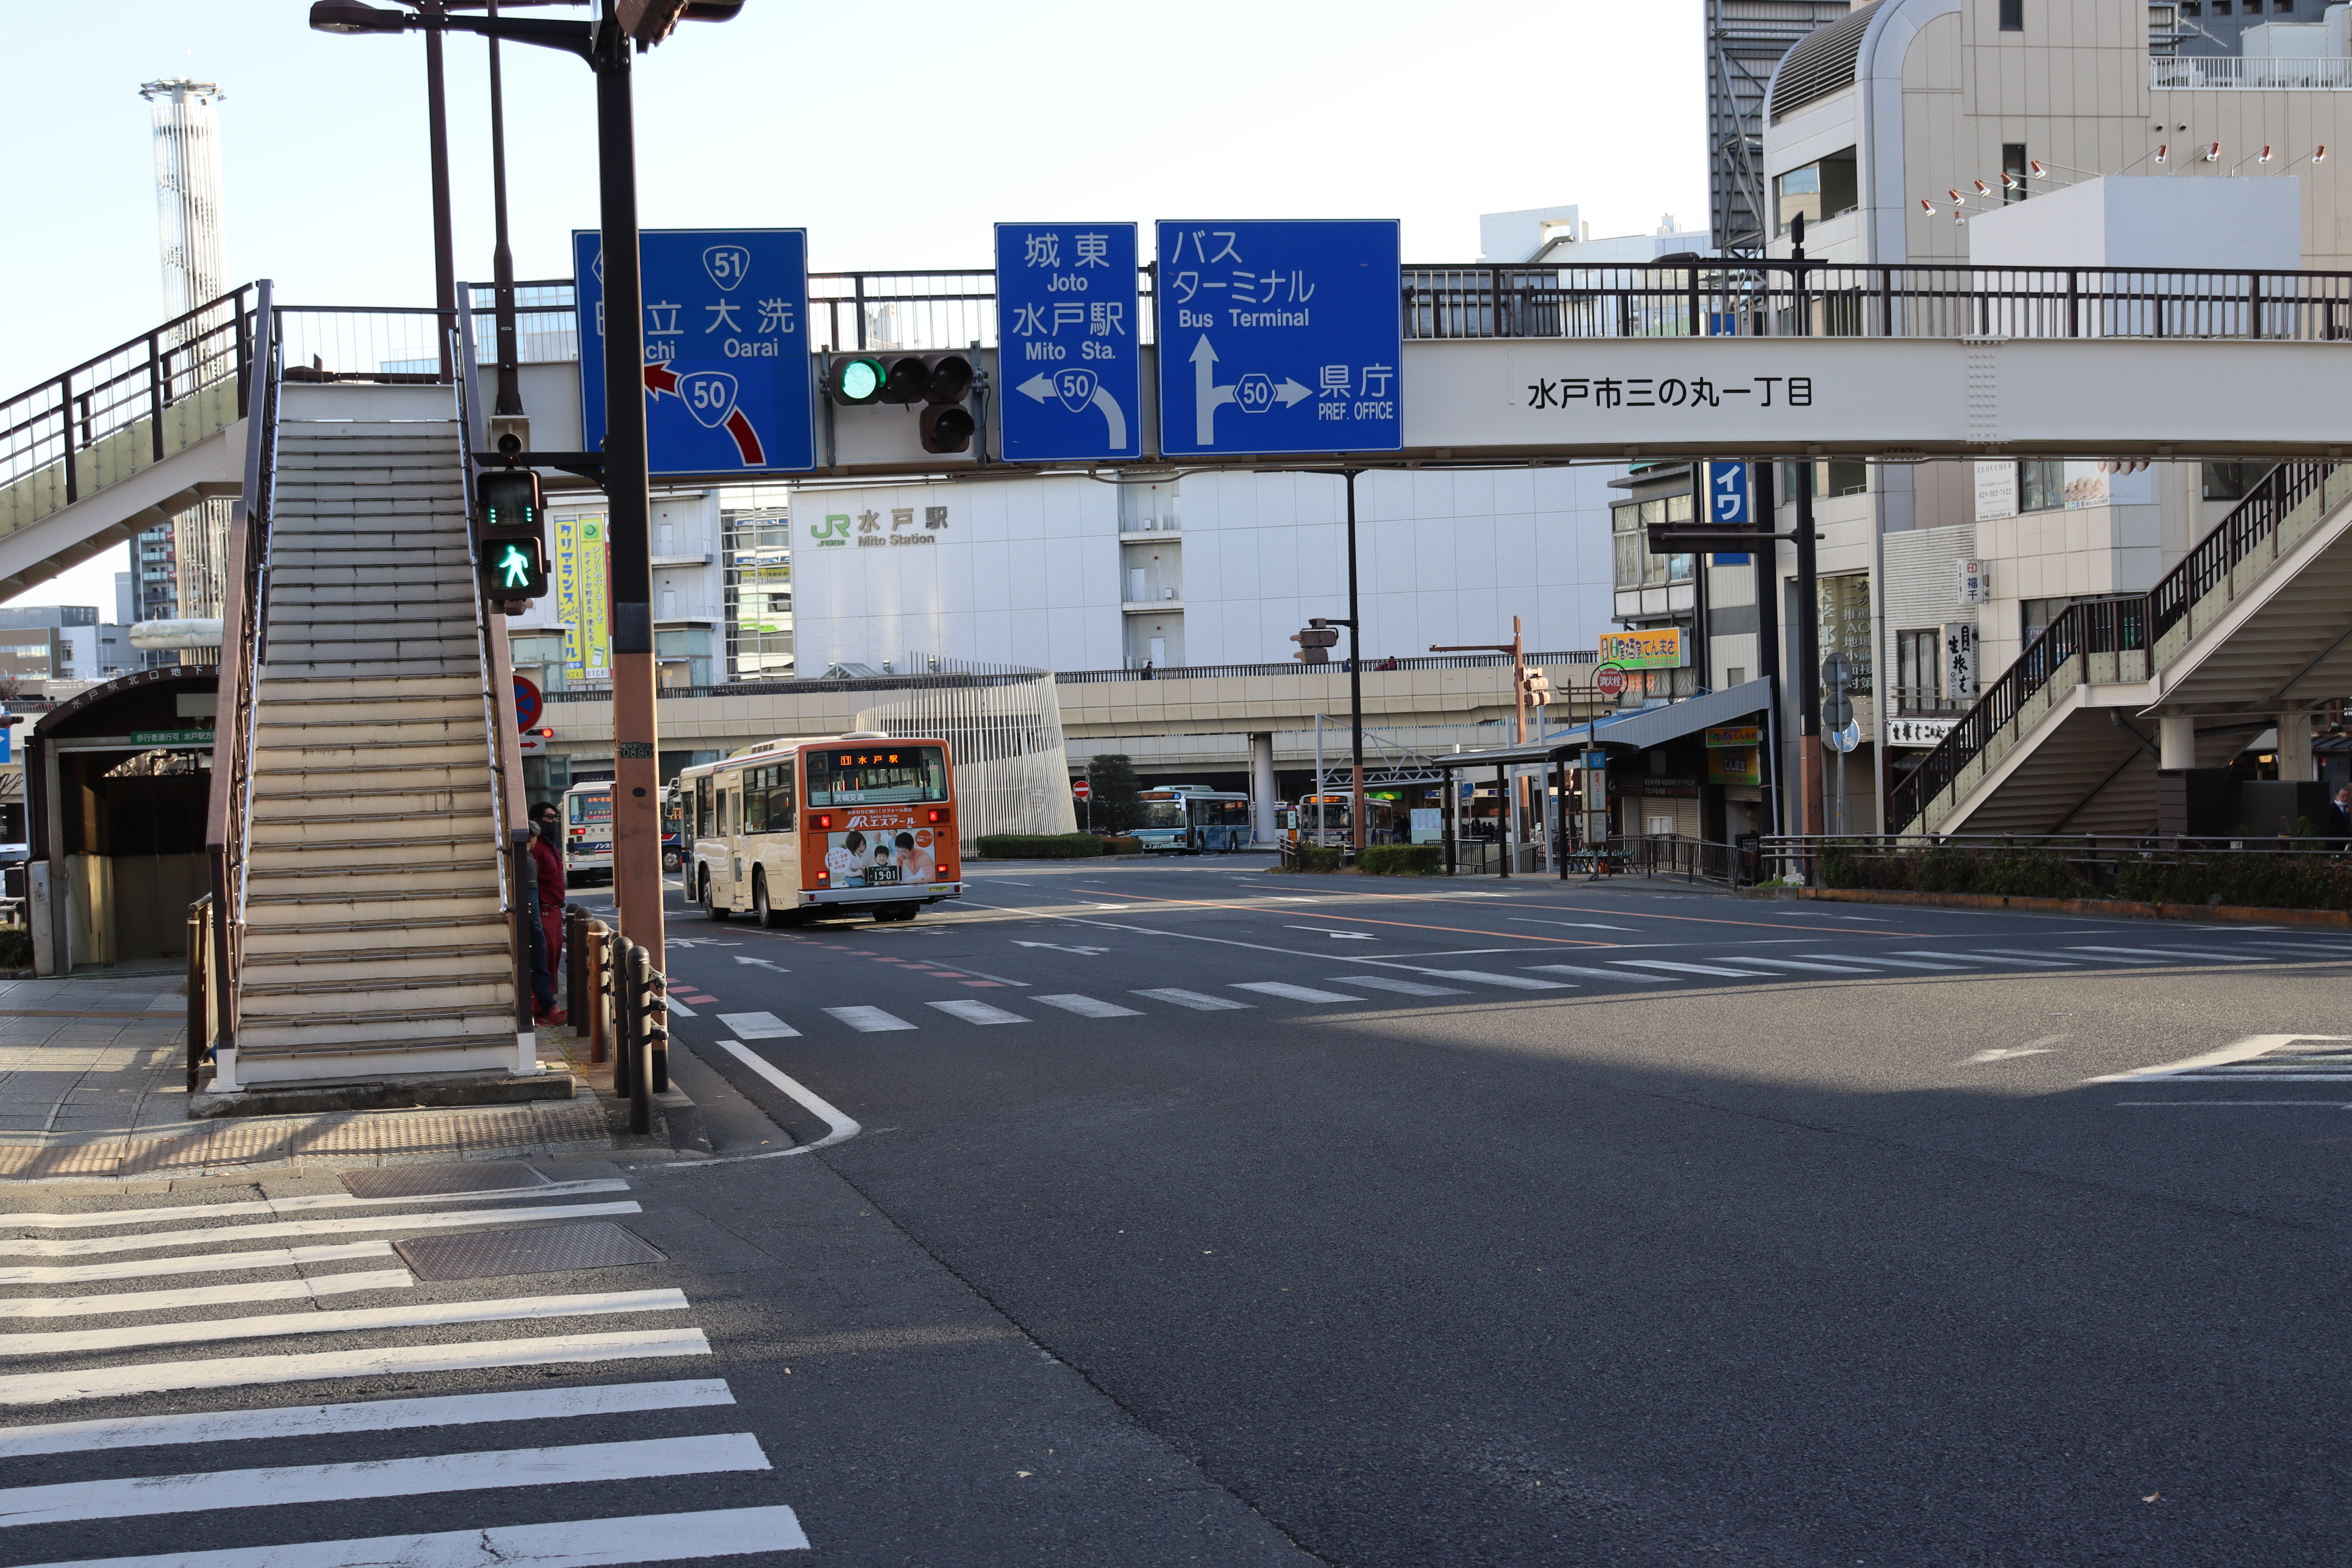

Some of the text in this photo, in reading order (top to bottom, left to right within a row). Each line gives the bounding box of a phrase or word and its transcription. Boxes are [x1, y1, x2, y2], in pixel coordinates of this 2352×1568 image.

[1024, 232, 1110, 269] 城東
[1172, 230, 1242, 263] バス
[714, 252, 740, 278] 51
[1047, 273, 1088, 292] Joto
[1172, 270, 1315, 304] ターミナル
[705, 298, 795, 334] 大洗
[1013, 302, 1125, 336] 水戸駅
[1179, 308, 1309, 328] Bus Terminal
[724, 338, 779, 358] Oarai
[1026, 340, 1116, 361] Mito Sta.
[1063, 376, 1089, 397] 50
[1319, 363, 1394, 398] 県庁
[693, 381, 726, 409] 50
[1243, 382, 1268, 404] 50
[1528, 377, 1812, 409] 水戸市三の丸一丁目
[1319, 401, 1394, 421] PREF. OFFICE
[1977, 463, 2012, 474] CLOUCHER
[1978, 488, 2012, 498] 029-302-7622
[858, 506, 948, 533] 水戸駅
[1980, 511, 2011, 519] www.cloucher.jp
[811, 514, 851, 539] JR
[858, 533, 935, 547] Mito Station
[561, 524, 574, 604] クリアランス
[1967, 563, 1978, 601] 印 福千
[558, 606, 580, 620] Sale
[1842, 608, 1870, 621] 推薦
[1846, 622, 1871, 634] AO
[1844, 636, 1871, 648] 地域
[1846, 650, 1872, 662] 小論
[587, 669, 608, 677] excel
[1599, 676, 1621, 687] 消火栓
[137, 733, 180, 742] 歩行者通行可
[623, 748, 652, 757] 089D
[858, 755, 898, 764] 水戸駅
[1593, 755, 1601, 765] 9
[834, 793, 865, 802] 茨城交通
[870, 817, 917, 827] エスアール
[875, 870, 895, 880] 19-01
